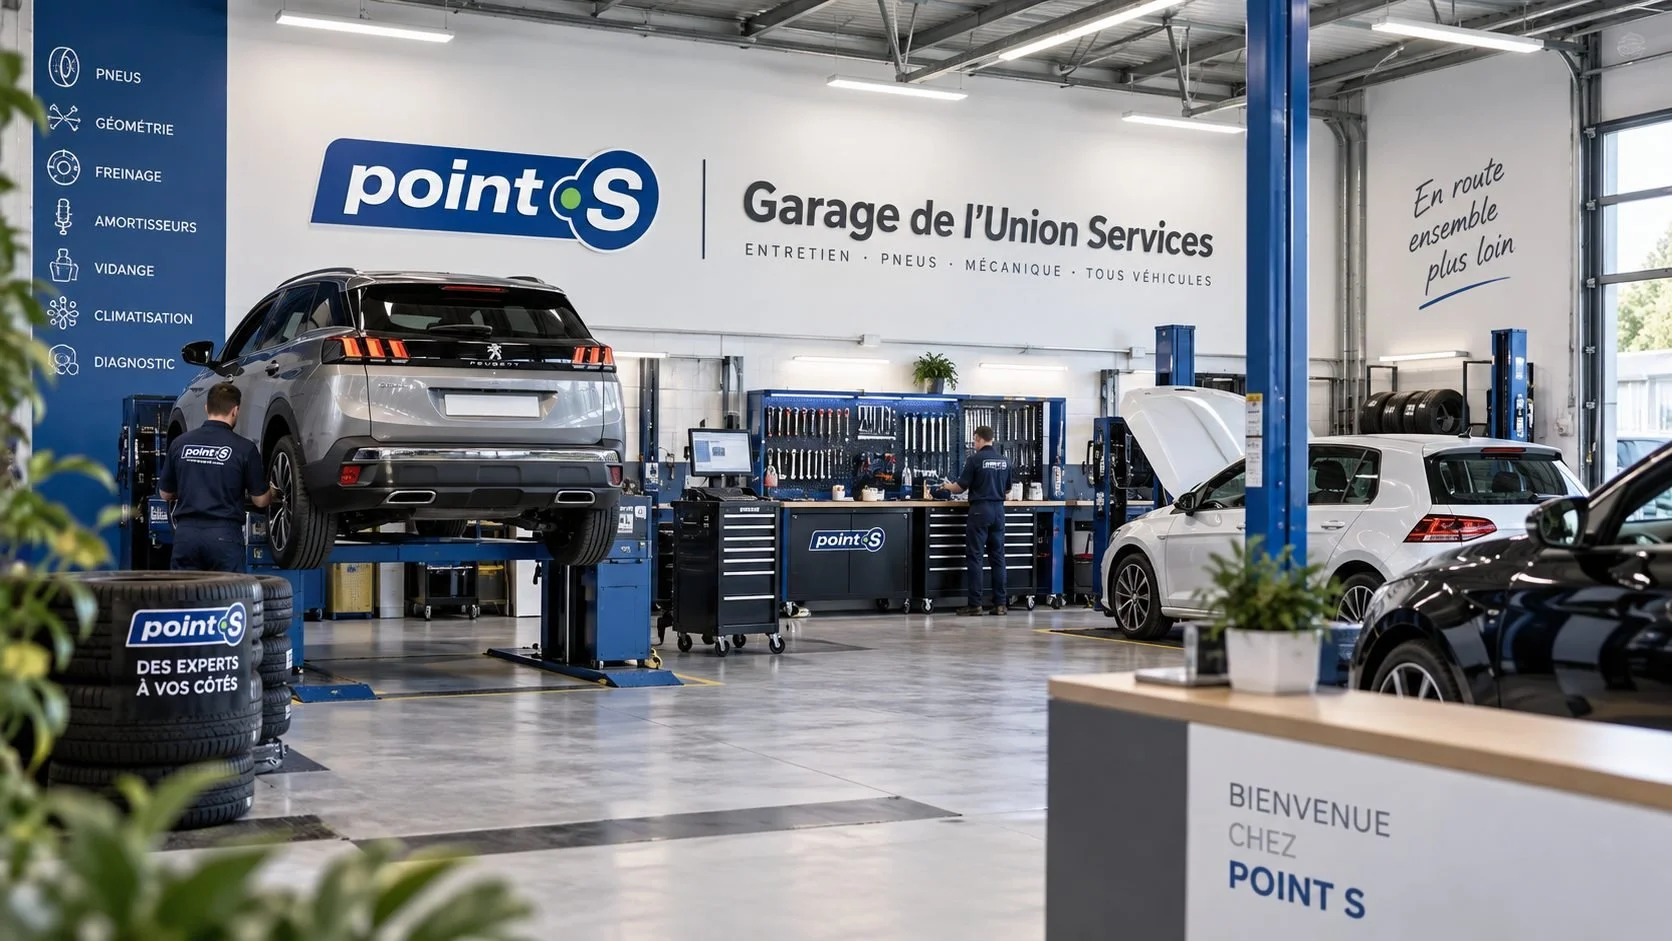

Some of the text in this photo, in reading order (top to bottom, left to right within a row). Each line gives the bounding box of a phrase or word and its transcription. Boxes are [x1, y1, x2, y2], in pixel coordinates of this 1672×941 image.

[96, 68, 142, 84] PNEUS
[95, 115, 174, 136] GÉOMÉTRIE
[95, 166, 162, 182] FREINAGE
[343, 159, 643, 232] point S
[1414, 158, 1505, 219] En route
[95, 215, 197, 233] AMORTISSEURS
[743, 180, 1214, 258] Garage de l’Union Services
[1409, 195, 1498, 252] ensemble
[94, 262, 155, 277] VIDANGE
[745, 243, 1212, 287] ENTRETIEN PNEUS MÉCANIQUE TOUS VÉHICULES
[1425, 234, 1514, 296] plus loin
[94, 309, 193, 325] CLIMATISATION
[94, 356, 175, 370] DIAGNOSTIC
[185, 447, 215, 457] point
[815, 532, 882, 549] point S
[141, 611, 243, 642] point S
[136, 656, 239, 675] DES EXPERTS
[136, 674, 238, 697] À VOS CÔTÉS
[1229, 782, 1391, 838] BIENVENUE
[1228, 822, 1297, 859] CHEZ
[1229, 859, 1366, 919] POINT S
